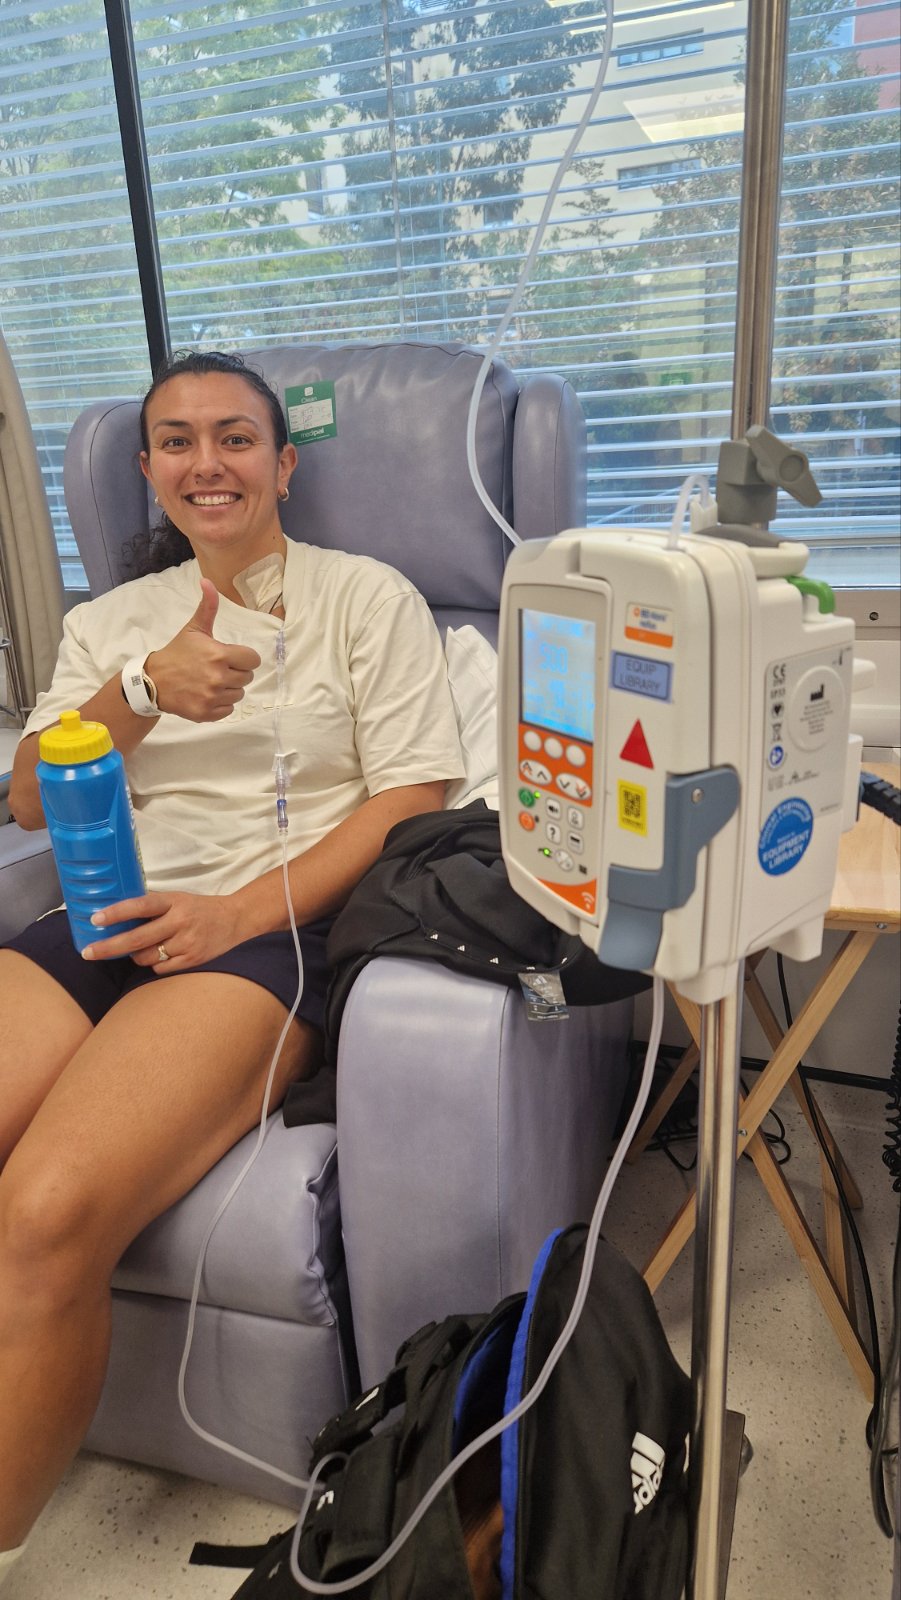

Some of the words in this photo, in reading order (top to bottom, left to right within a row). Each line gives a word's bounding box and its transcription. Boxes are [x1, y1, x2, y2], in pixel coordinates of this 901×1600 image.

[626, 659, 657, 675] EQUIP
[620, 673, 660, 690] LIBRARY
[762, 828, 809, 863] EQUIPMENT
[768, 842, 804, 869] LIBRARY
